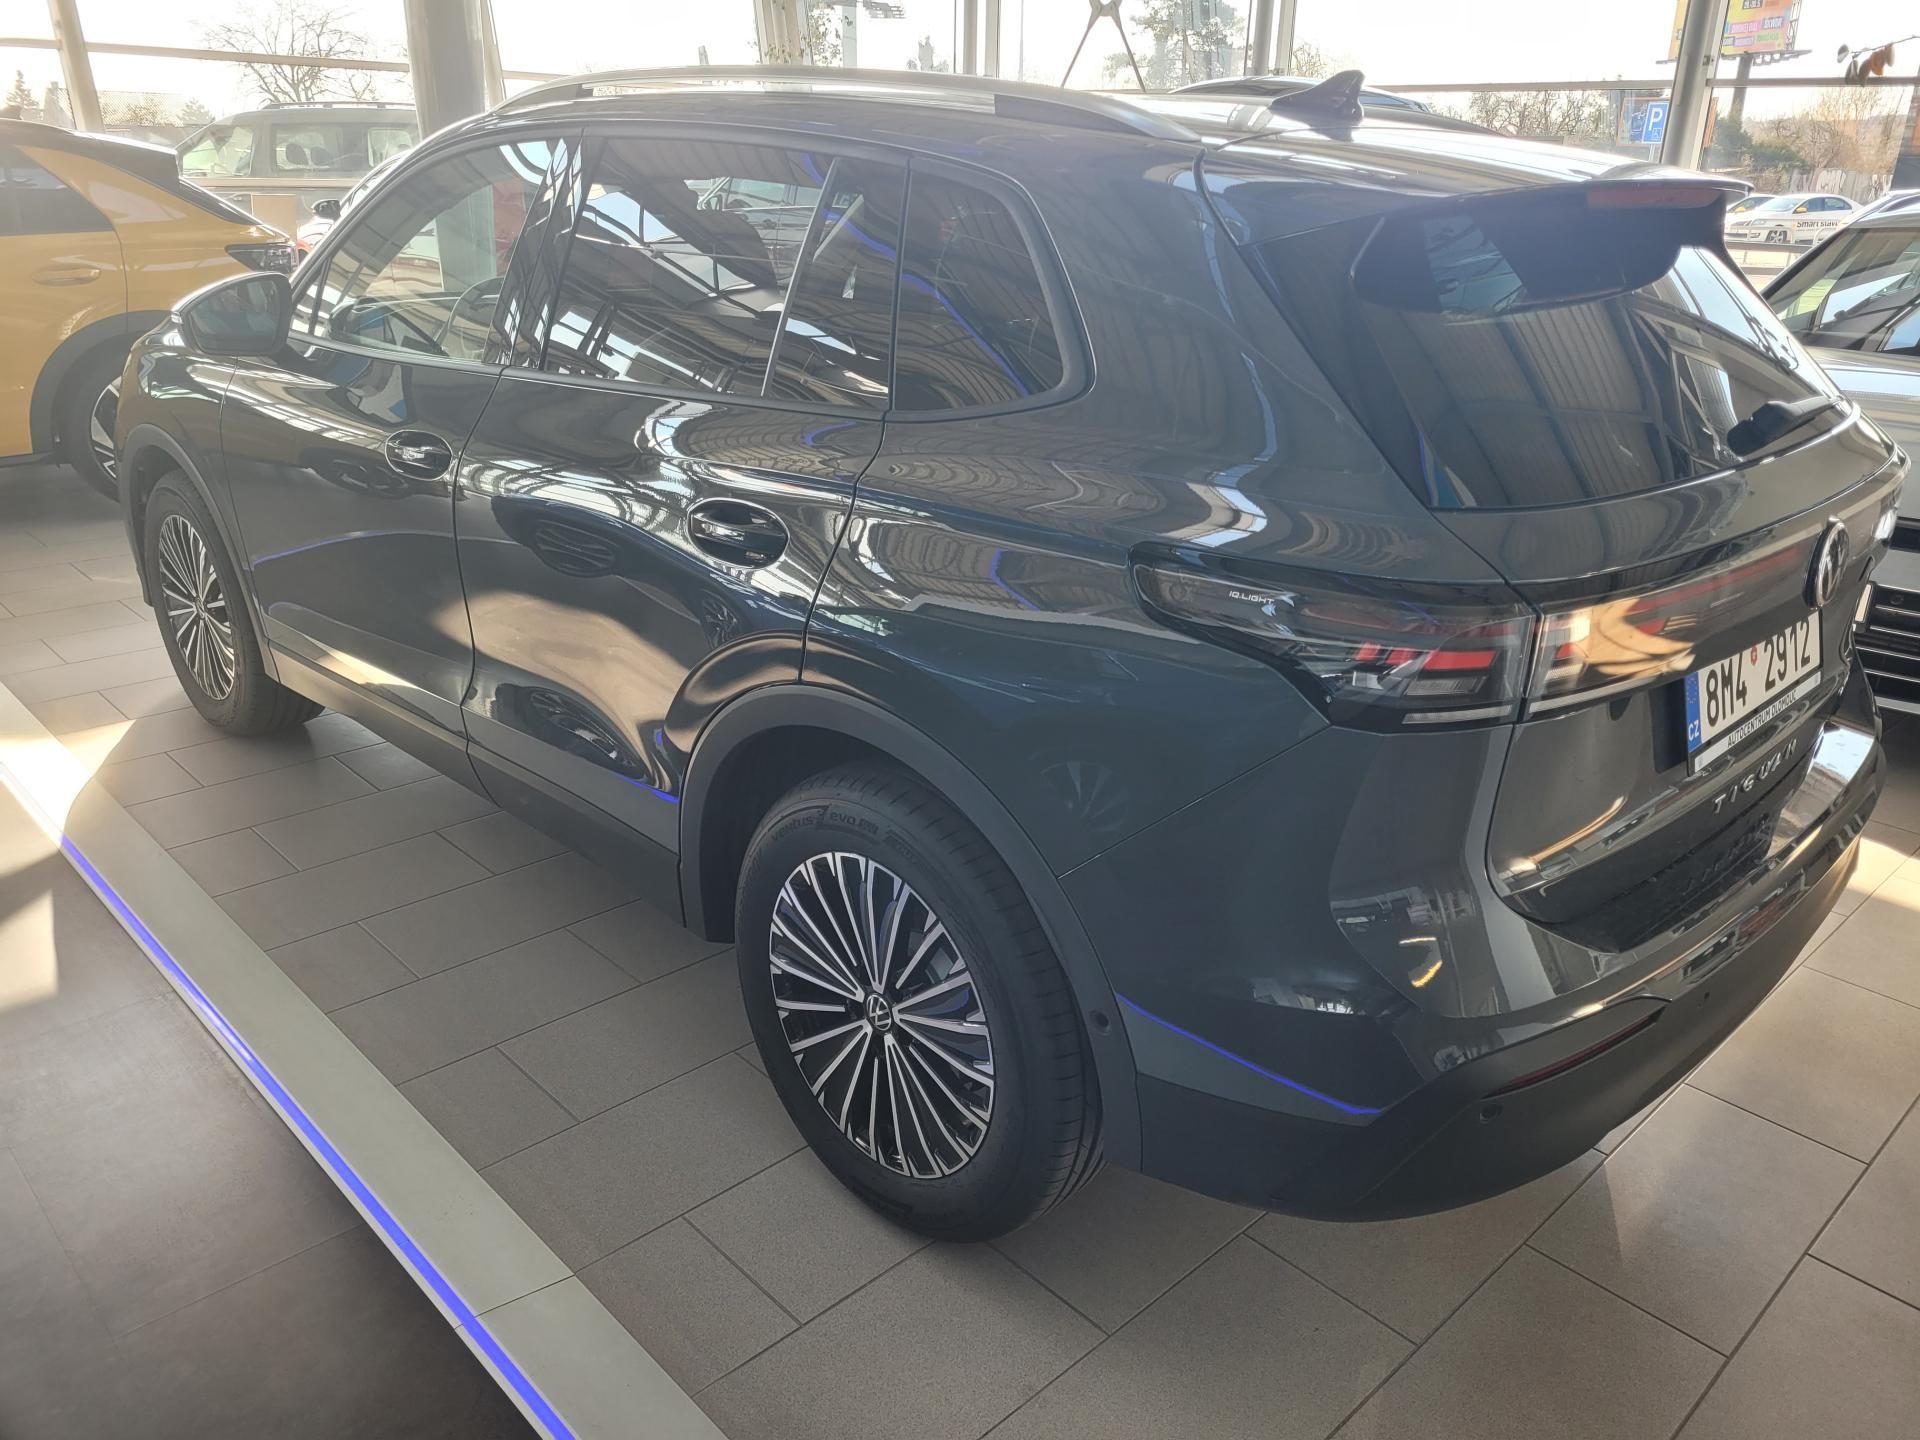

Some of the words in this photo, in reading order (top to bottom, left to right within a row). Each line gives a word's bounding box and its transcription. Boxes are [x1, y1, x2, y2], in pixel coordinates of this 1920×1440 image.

[1648, 107, 1663, 131] P
[1229, 591, 1275, 604] IQ.LIGHT
[1706, 652, 1747, 727] 8M4
[1764, 620, 1811, 692] 2912
[1688, 720, 1700, 741] CZ
[1727, 707, 1771, 748] AUTOCENTRUM
[1771, 690, 1797, 717] OLOMOUC
[1714, 739, 1797, 814] TIGUAN
